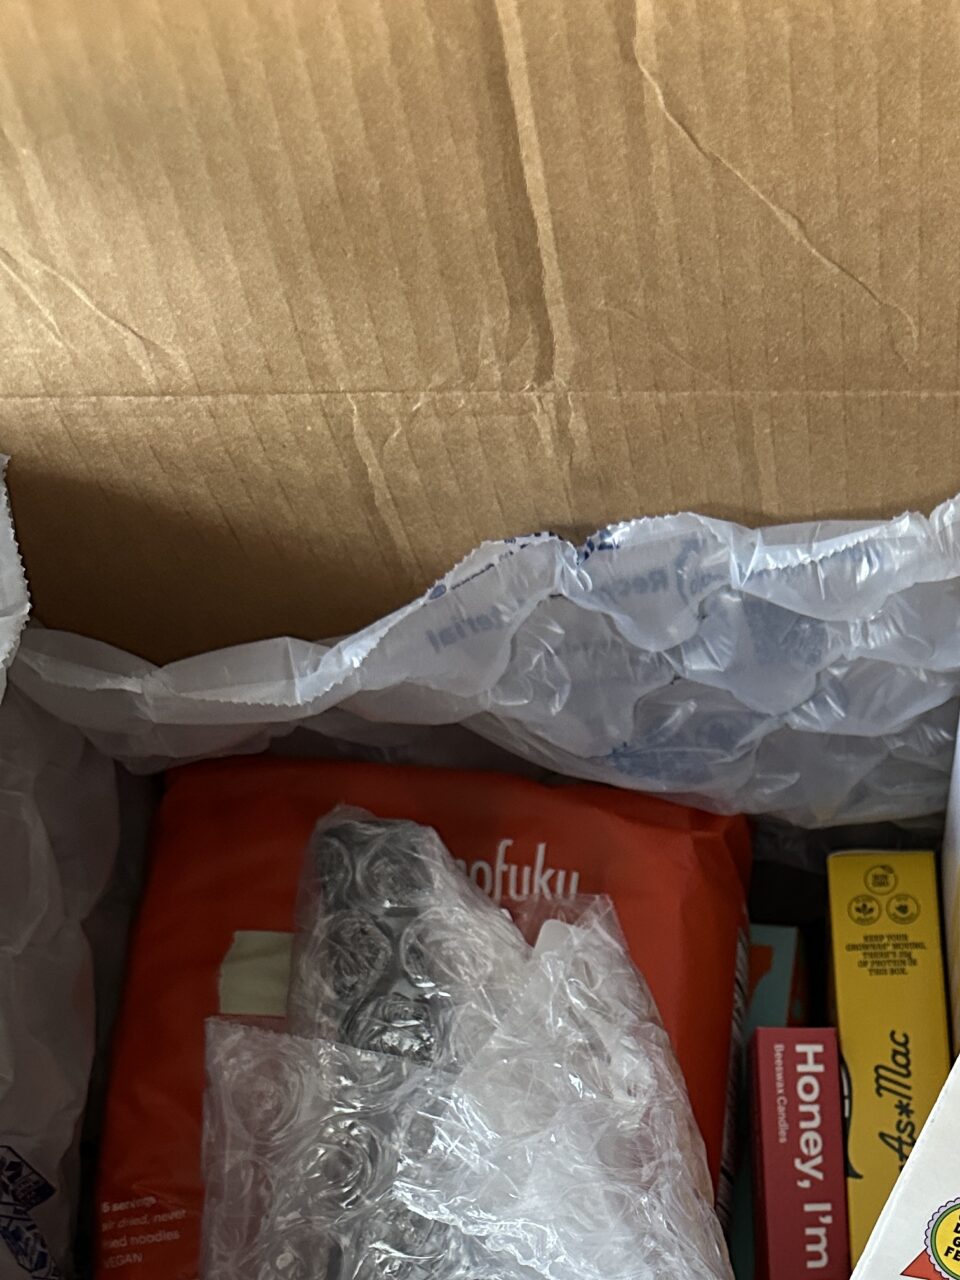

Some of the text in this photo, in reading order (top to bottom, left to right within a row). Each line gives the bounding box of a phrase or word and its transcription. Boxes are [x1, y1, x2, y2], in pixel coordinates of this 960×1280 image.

[773, 1044, 788, 1143] Beeswax Candles
[793, 1044, 825, 1189] Honey,
[130, 1230, 181, 1245] noodles
[803, 1202, 833, 1269] I'm
